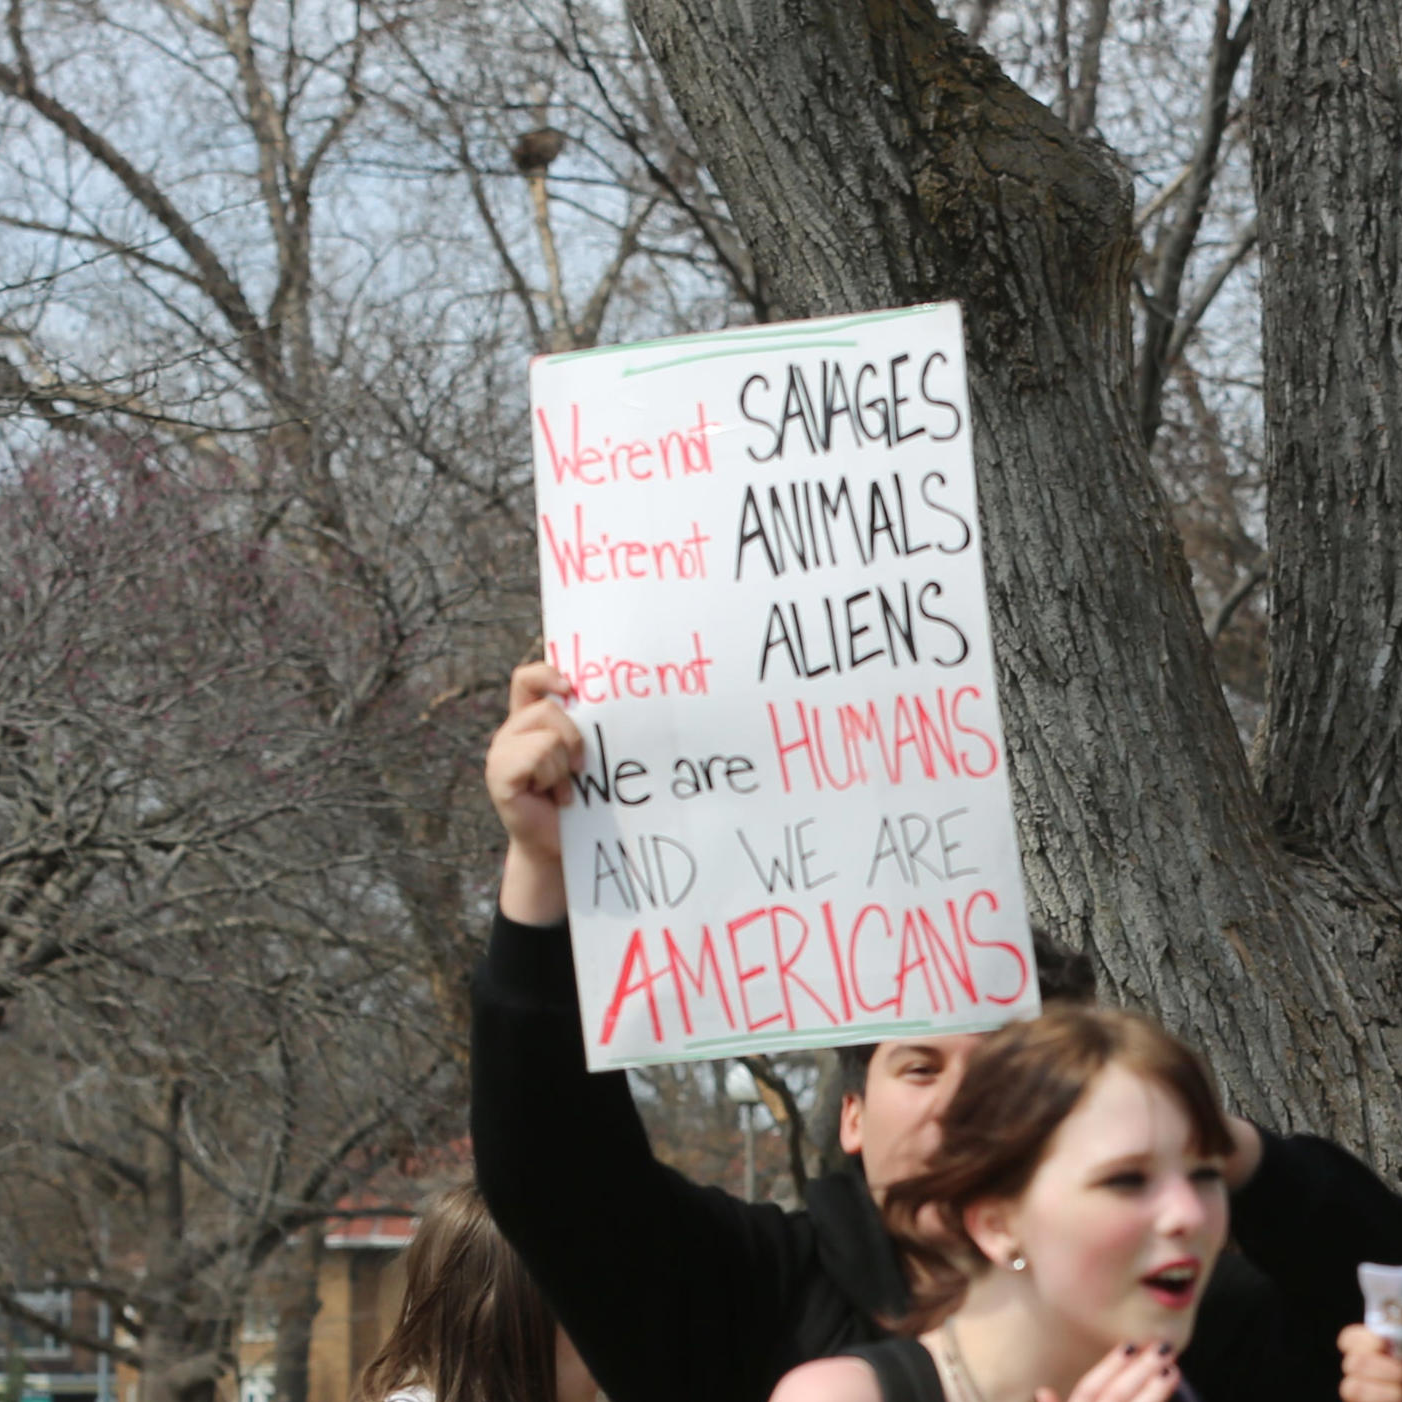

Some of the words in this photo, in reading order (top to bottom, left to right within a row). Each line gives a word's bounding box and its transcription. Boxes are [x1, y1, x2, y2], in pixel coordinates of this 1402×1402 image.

[658, 401, 721, 480] not
[737, 351, 963, 464] SAVAGES
[652, 521, 711, 579] not
[734, 471, 971, 581] ANIMALS
[654, 632, 713, 696] not
[758, 581, 971, 682] ALIENS
[570, 723, 653, 808] We
[670, 751, 761, 799] are
[767, 686, 1000, 795] HUMANS
[593, 834, 698, 912] AND
[735, 817, 839, 895] WE
[866, 807, 982, 889] ARE
[598, 889, 1029, 1046] AMERICANS
